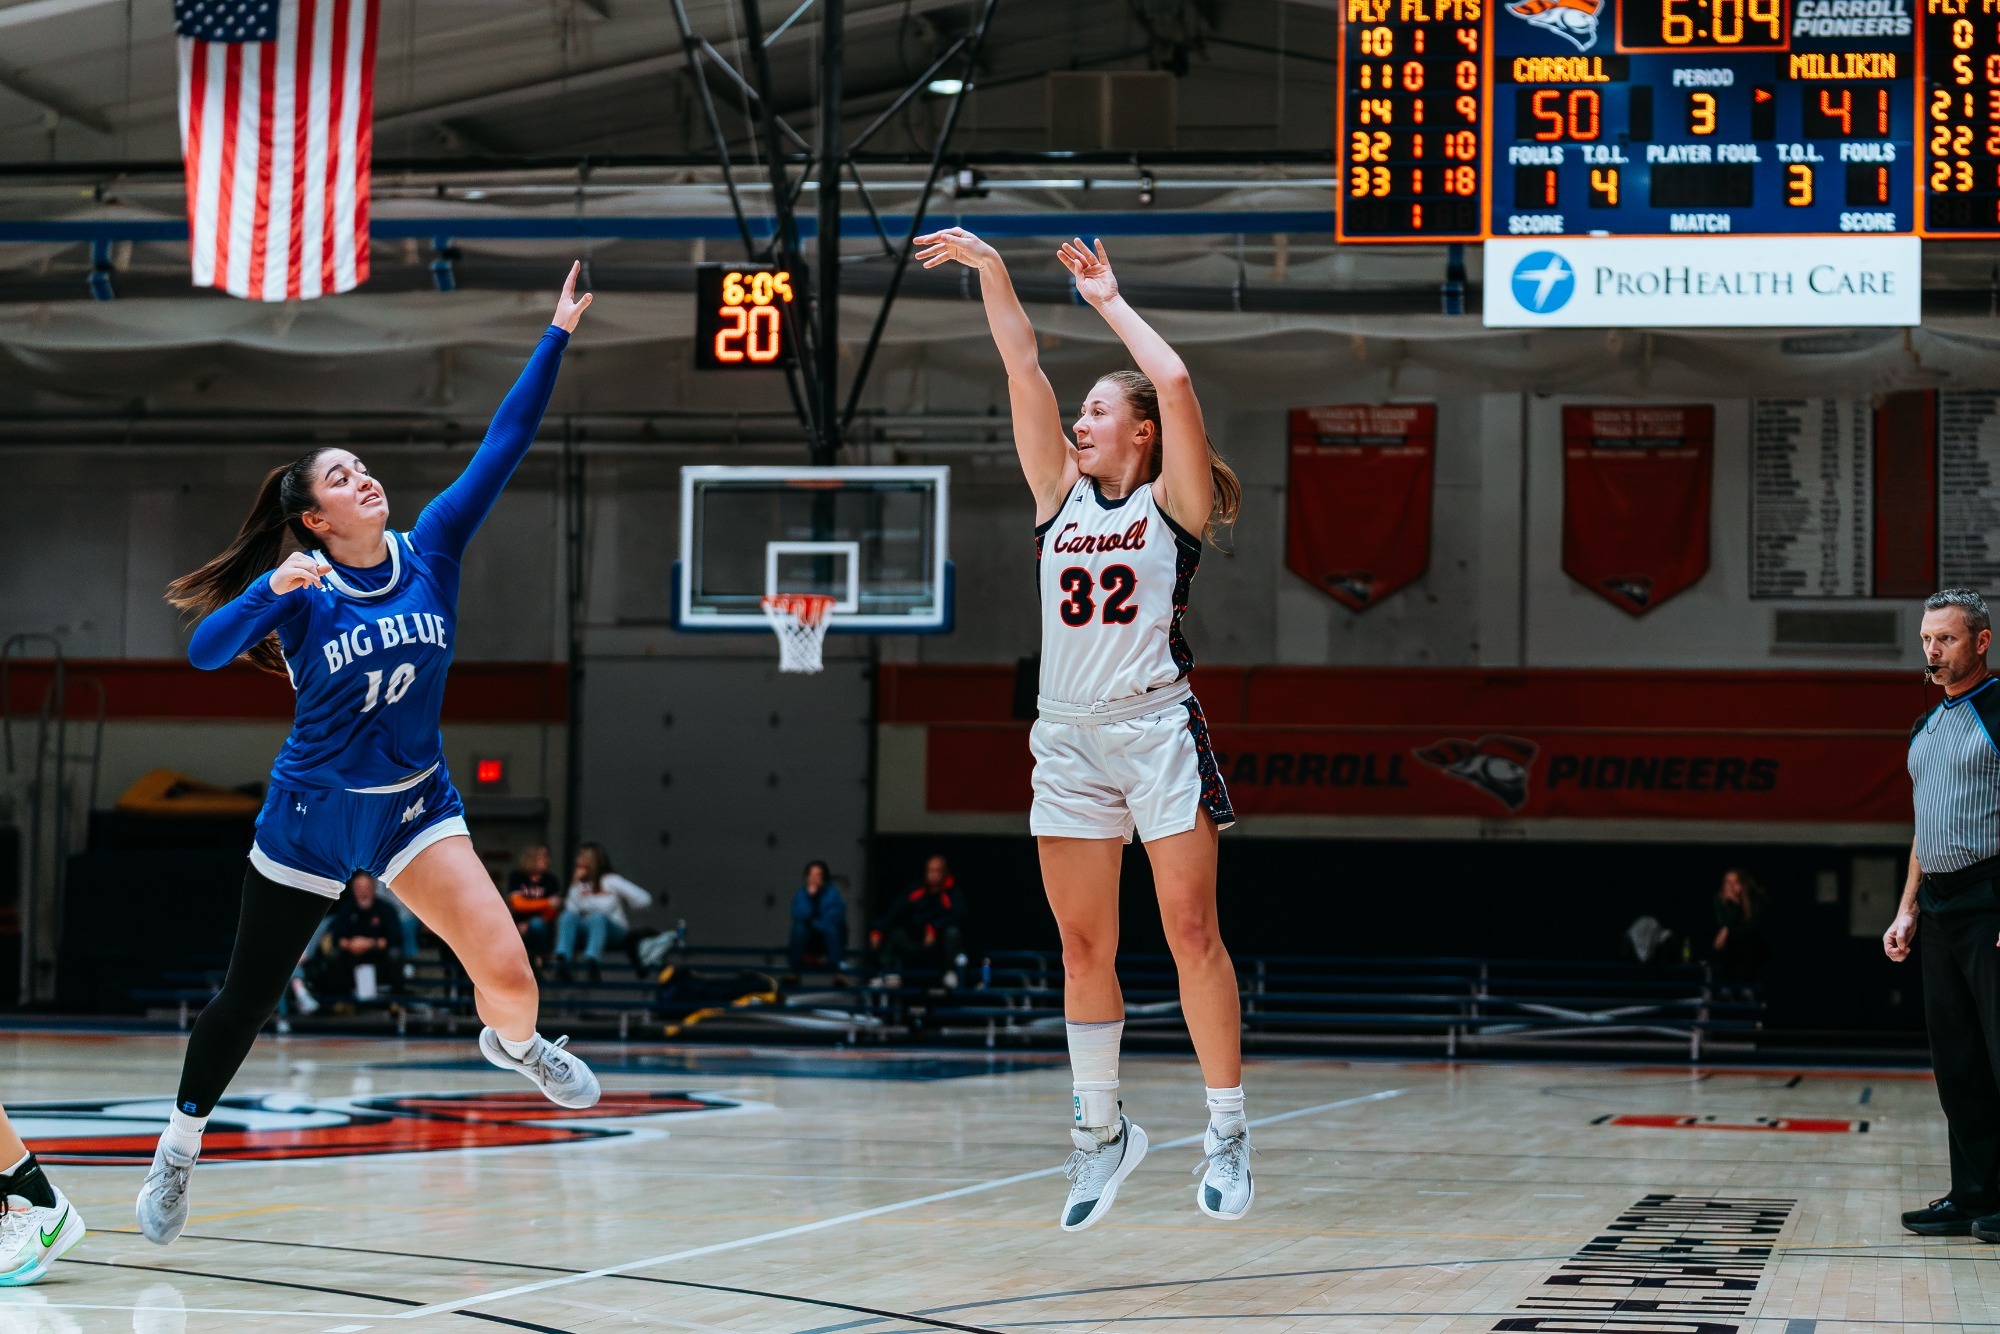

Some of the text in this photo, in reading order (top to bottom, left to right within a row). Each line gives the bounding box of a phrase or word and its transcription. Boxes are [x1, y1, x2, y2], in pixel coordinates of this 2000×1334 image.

[1401, 0, 1430, 22] FL
[1435, 0, 1481, 22] PTS
[1796, 0, 1908, 18] CARROLL
[1361, 26, 1478, 57] 10 1 4
[1792, 17, 1913, 37] PIONEERS
[1953, 18, 1974, 50] 0
[1361, 60, 1477, 92] 11 0 0
[1513, 56, 1610, 83] CARROLL
[1672, 68, 1734, 87] PERIOD
[1789, 53, 1896, 80] MILLIKIN
[1952, 54, 1974, 85] 5
[1361, 95, 1477, 125] 14 1 9
[1532, 89, 1600, 141] 50
[1691, 93, 1716, 135] 3
[1819, 89, 1889, 135] 41
[1930, 89, 1974, 121] 21
[1351, 130, 1477, 162] 32 1 10
[1508, 145, 1565, 165] FOULS
[1646, 143, 1762, 164] PLAYER FOUL
[1840, 142, 1896, 163] FOULS
[1930, 125, 1974, 157] 22
[1351, 165, 1476, 198] 33 1 18
[1545, 169, 1557, 205] 1
[1591, 169, 1618, 206] 4
[1788, 164, 1813, 207] 3
[1877, 166, 1889, 203] 1
[1930, 160, 1974, 193] 23
[1411, 203, 1423, 229] 1
[1508, 214, 1565, 235] SCORE
[1670, 213, 1731, 233] MATCH
[1840, 212, 1896, 232] SCORE
[714, 305, 780, 363] 20
[1053, 516, 1149, 555] Carroll
[1059, 563, 1140, 628] 32
[323, 612, 447, 675] BIG BLUE
[360, 662, 417, 713] 10
[1546, 755, 1780, 791] PIONEERS
